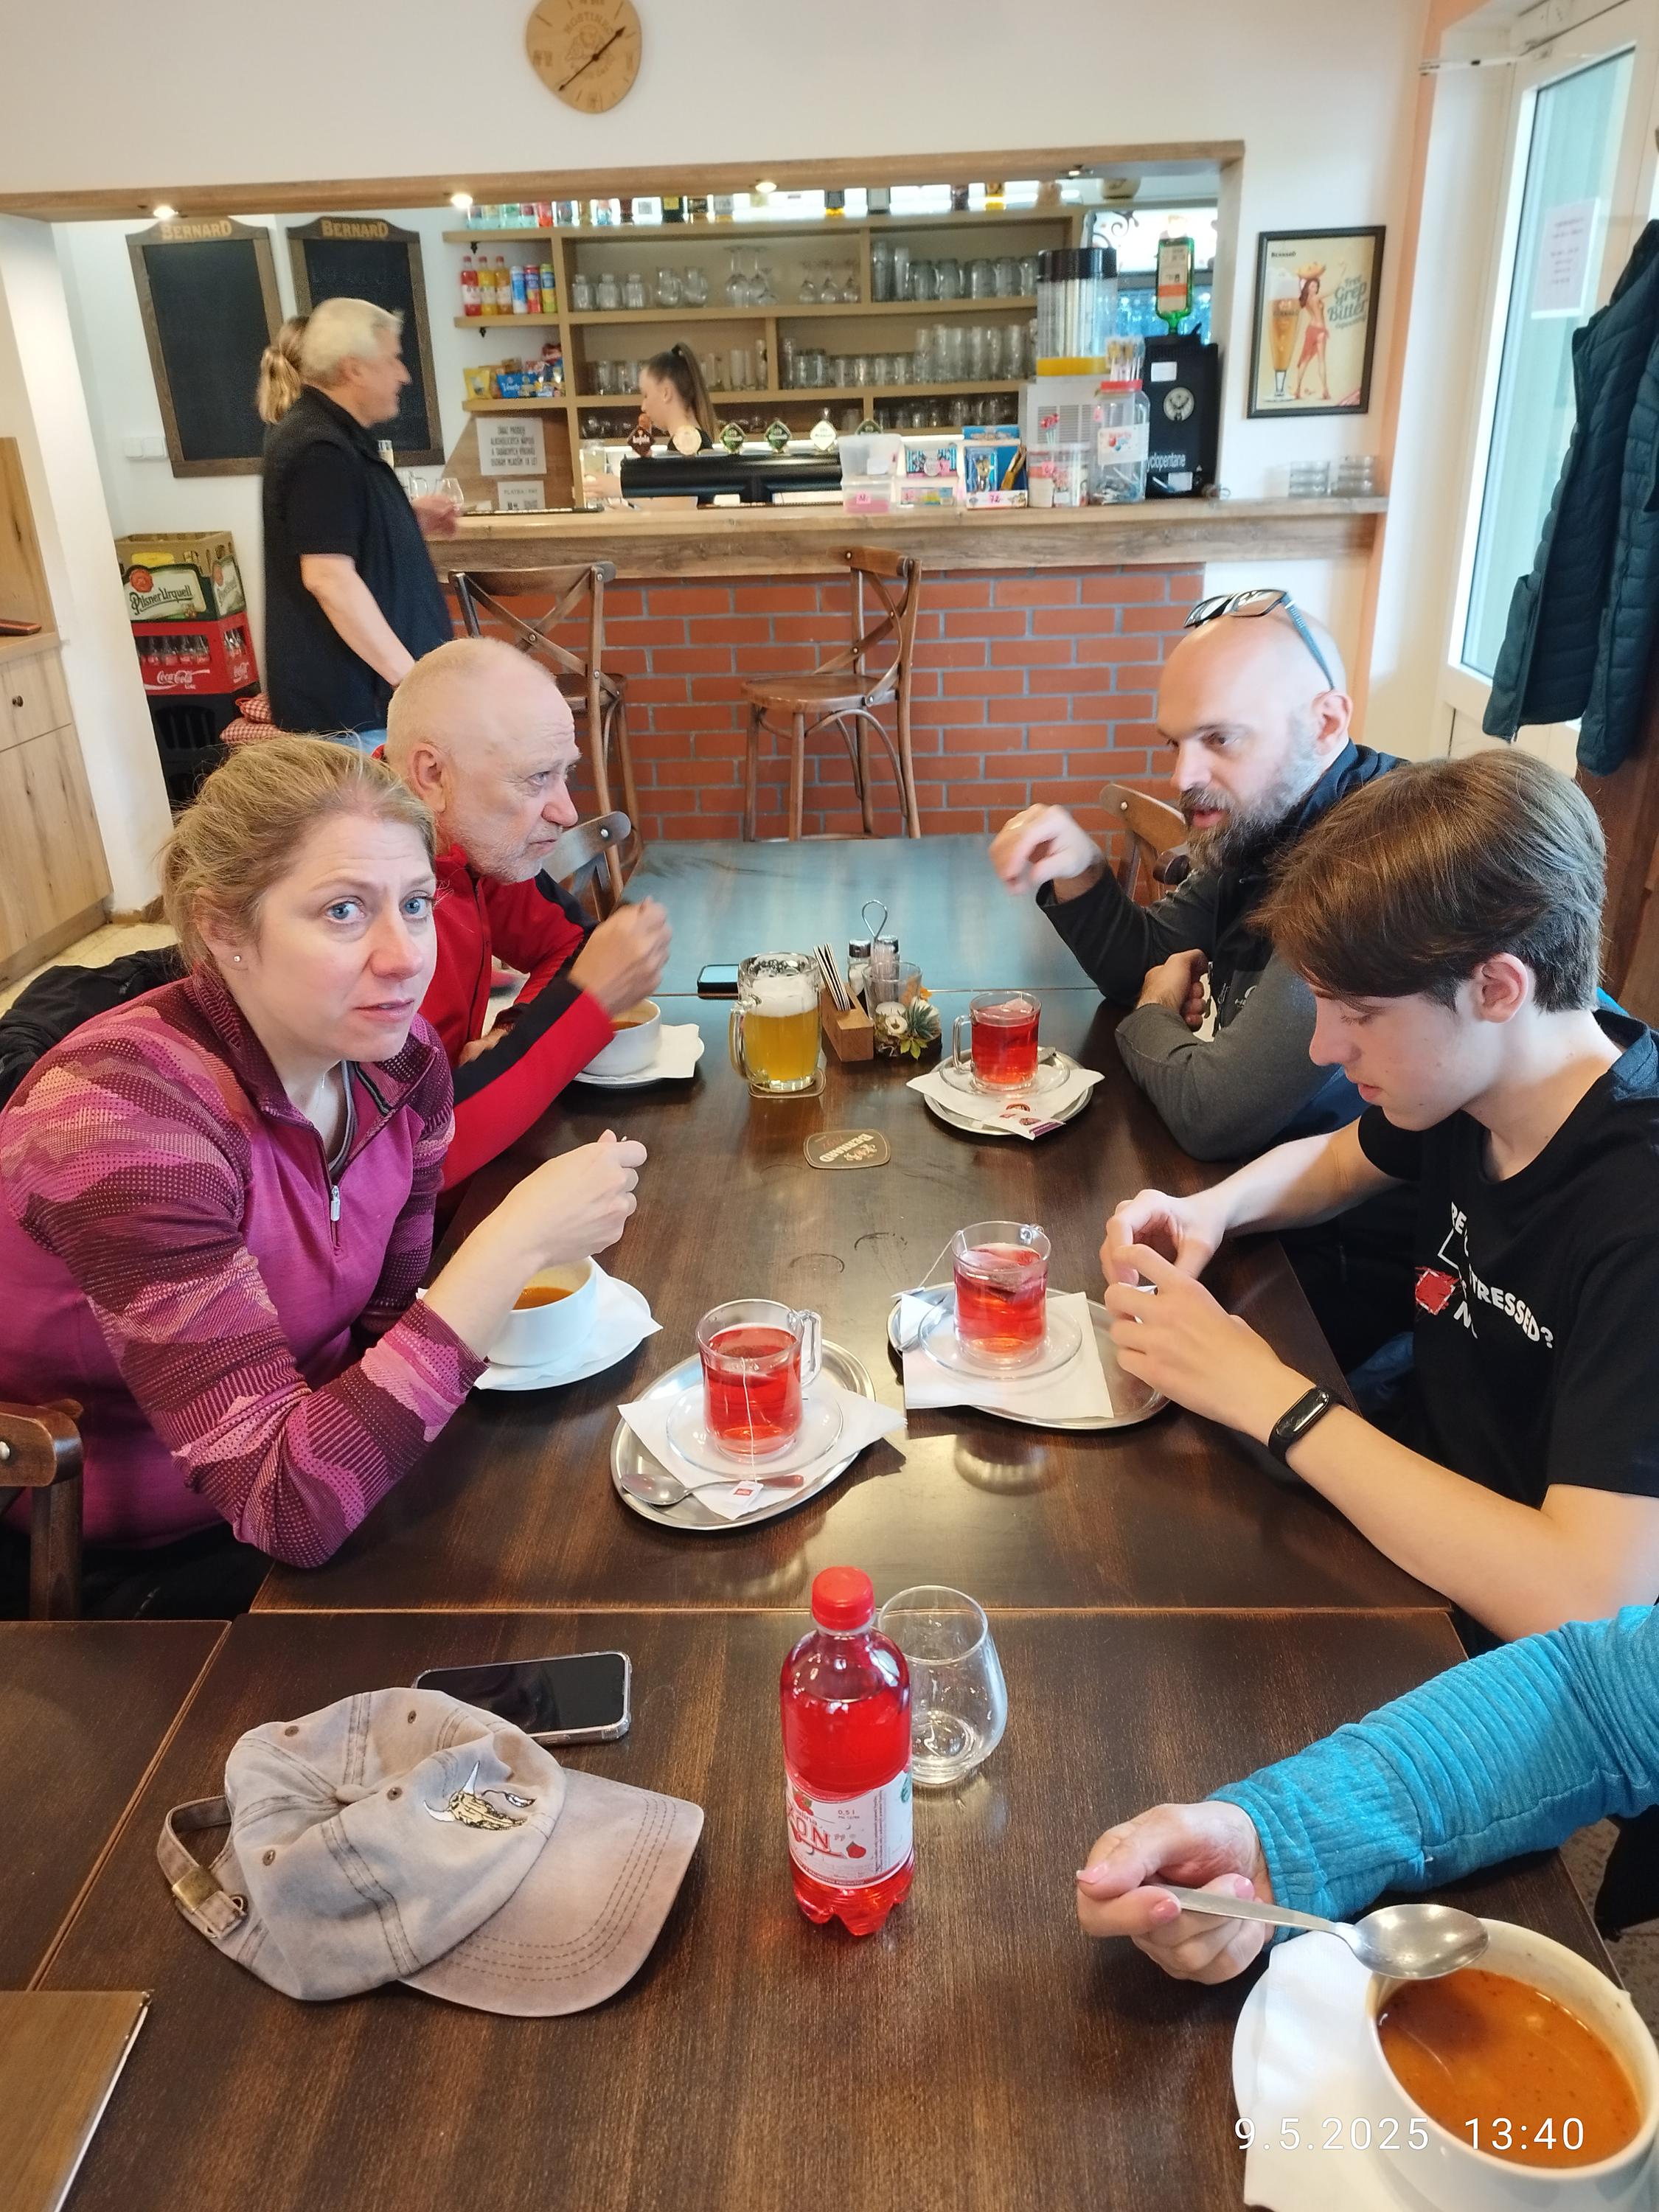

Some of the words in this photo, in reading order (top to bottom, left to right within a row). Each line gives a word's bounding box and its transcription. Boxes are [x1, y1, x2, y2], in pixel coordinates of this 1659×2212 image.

[160, 220, 232, 240] BERNARD
[321, 219, 389, 238] BERNARD
[1145, 452, 1186, 473] yclopentane
[129, 591, 161, 615] Pilsner
[158, 585, 192, 603] Urquell
[819, 1133, 874, 1162] BERNARD
[1451, 1201, 1467, 1234] RE
[1470, 1265, 1554, 1349] TRESSED?
